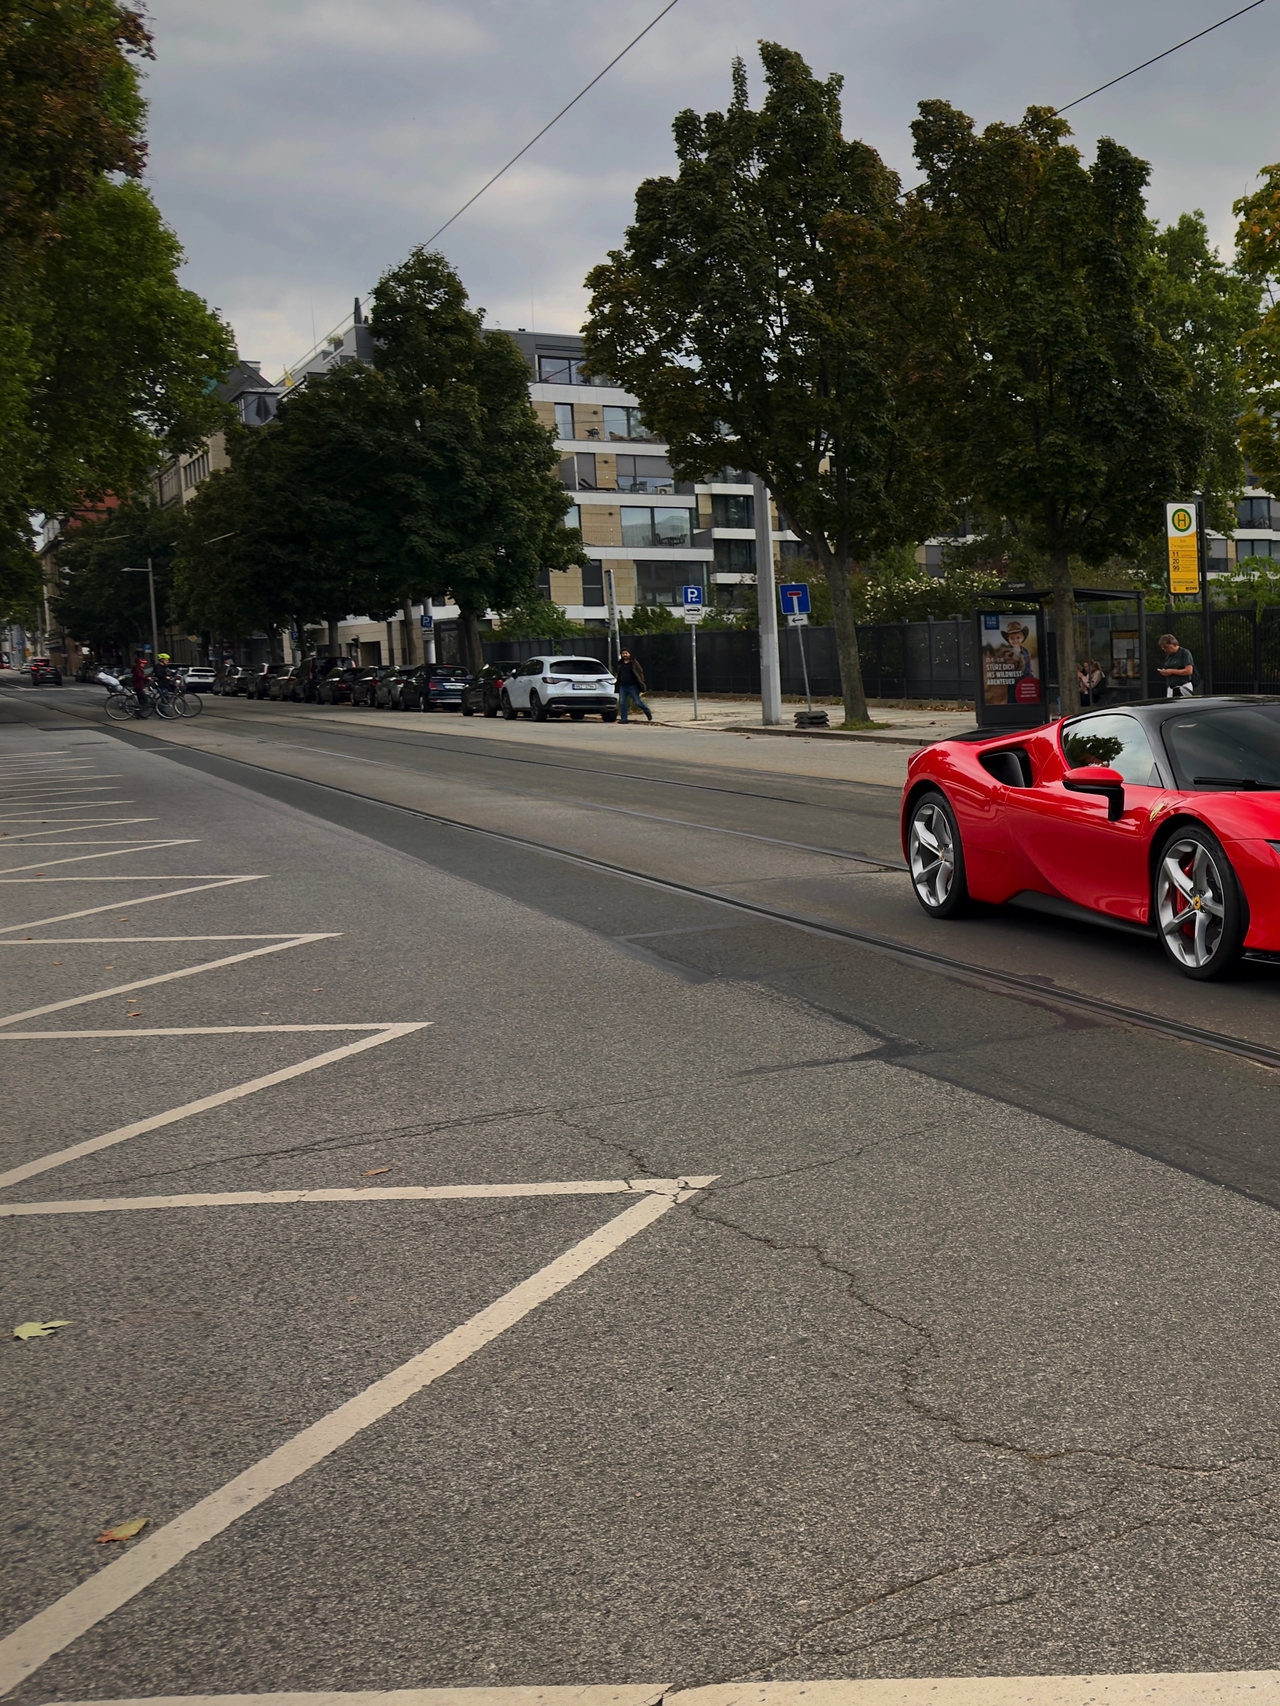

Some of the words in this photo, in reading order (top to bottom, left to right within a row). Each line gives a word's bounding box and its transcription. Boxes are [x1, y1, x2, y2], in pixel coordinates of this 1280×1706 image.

[1177, 514, 1186, 527] H
[687, 588, 698, 602] P
[422, 616, 430, 626] P
